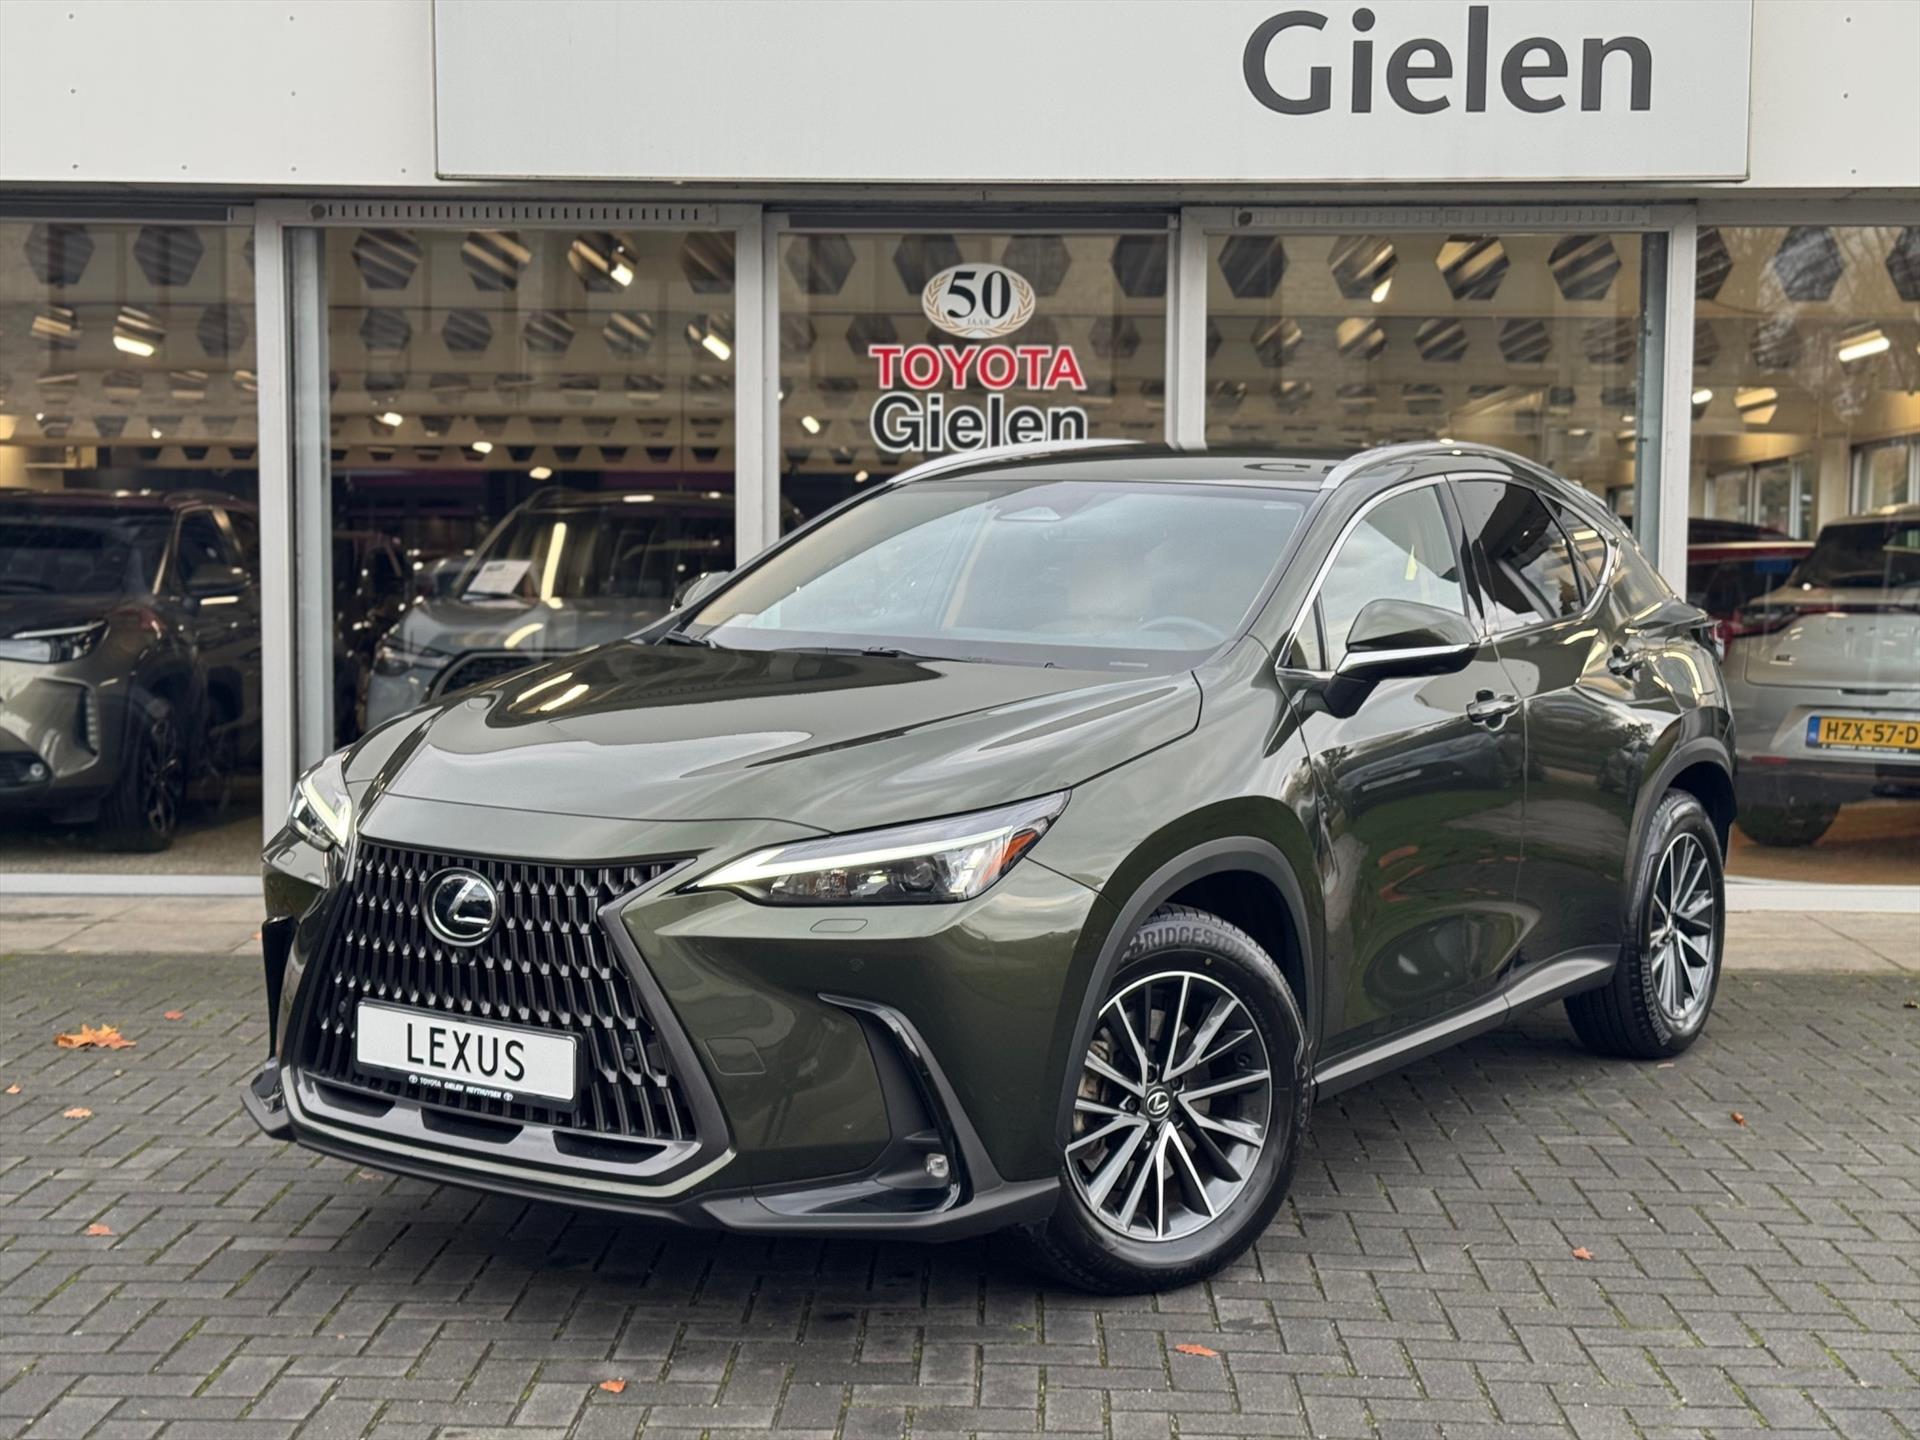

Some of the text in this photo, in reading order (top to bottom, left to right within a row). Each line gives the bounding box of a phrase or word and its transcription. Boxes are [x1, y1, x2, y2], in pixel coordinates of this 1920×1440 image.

[1242, 5, 1652, 115] Gielen
[946, 270, 1012, 319] 50
[868, 344, 1087, 391] TOYOTA
[870, 391, 1088, 453] Gielen
[1825, 721, 1919, 744] HZX-57-D
[407, 1023, 525, 1082] LEXUS
[420, 1077, 442, 1088] TOYOTA
